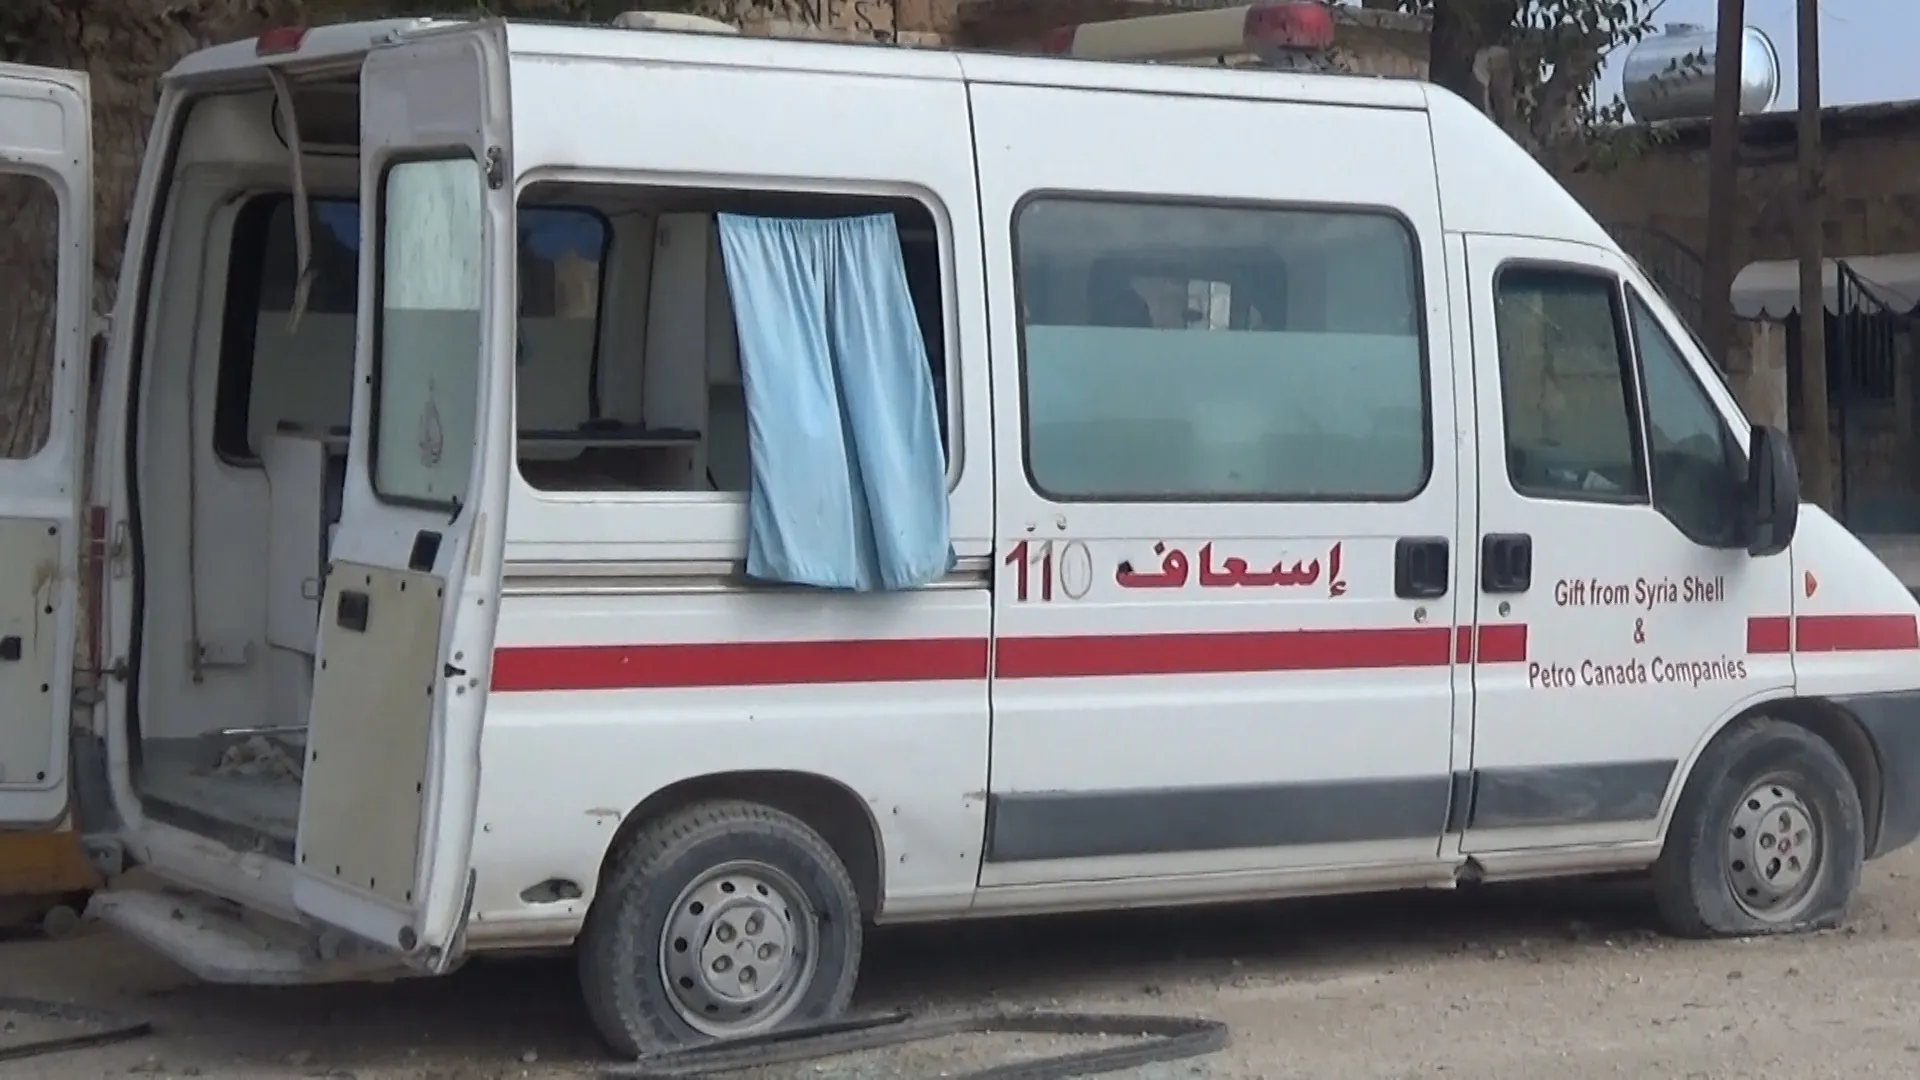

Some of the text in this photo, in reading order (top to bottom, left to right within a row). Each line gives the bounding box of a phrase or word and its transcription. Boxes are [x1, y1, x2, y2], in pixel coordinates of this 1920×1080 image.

[1005, 539, 1347, 601] إسعاف 110
[1554, 575, 1724, 610] Gift from Syria Shell
[1633, 616, 1646, 644] &
[1529, 653, 1747, 689] Petro Canada Companies
